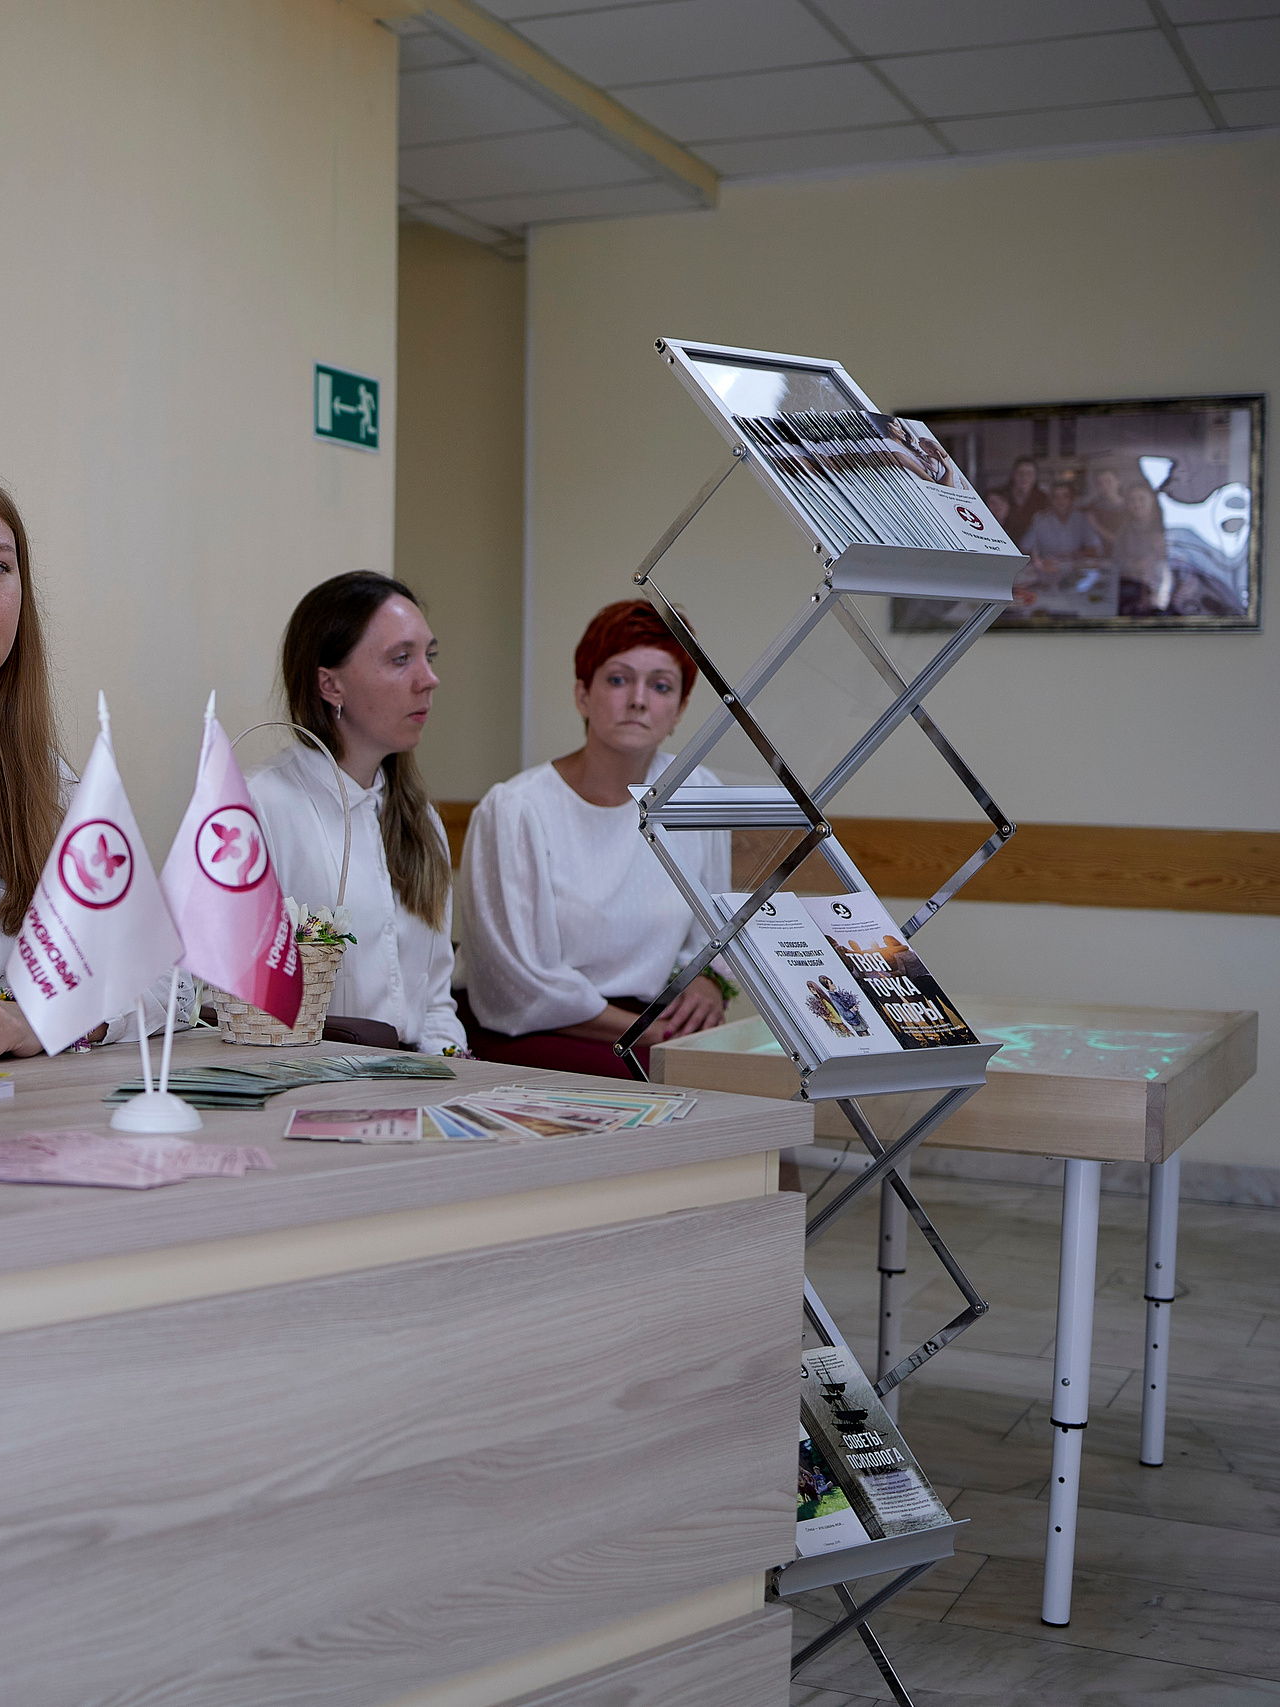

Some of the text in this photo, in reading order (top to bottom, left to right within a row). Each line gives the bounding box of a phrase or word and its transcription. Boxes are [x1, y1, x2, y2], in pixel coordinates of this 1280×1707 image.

[265, 907, 291, 970] КРАЕВО
[844, 951, 893, 973] ТВОЯ
[863, 975, 922, 998] ТОЧКА
[883, 999, 945, 1023] ОПОРЫ
[842, 1430, 884, 1450] СОВЕТЫ
[845, 1447, 906, 1470] ПСИХОЛОГА
